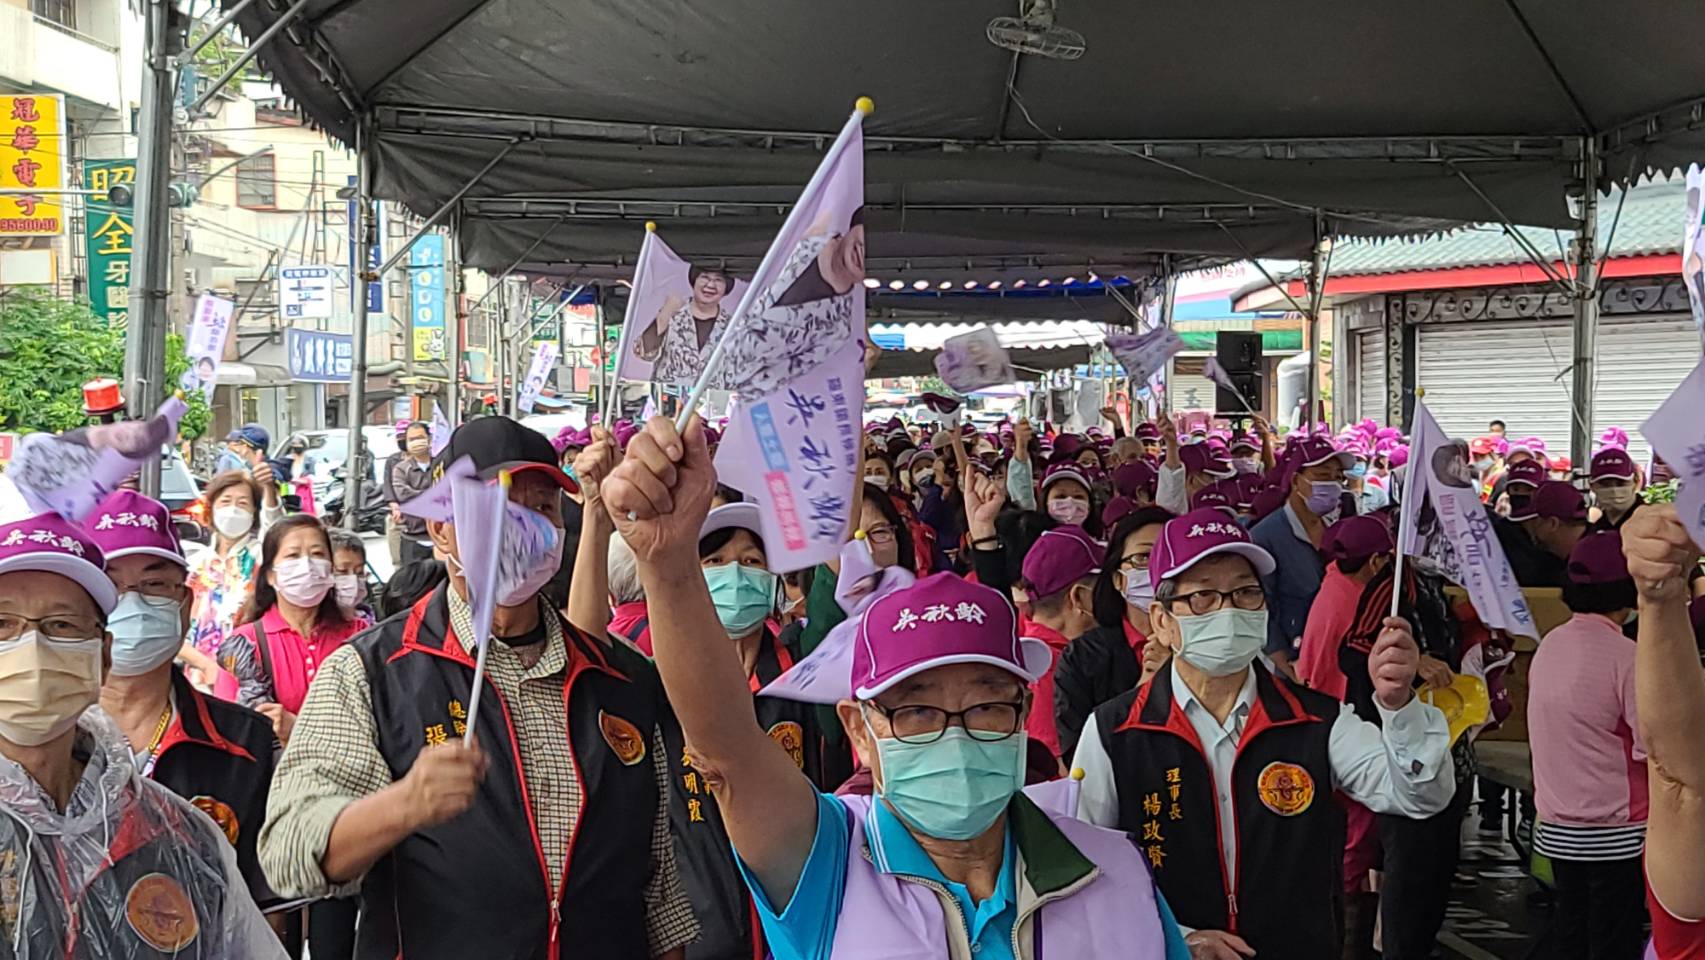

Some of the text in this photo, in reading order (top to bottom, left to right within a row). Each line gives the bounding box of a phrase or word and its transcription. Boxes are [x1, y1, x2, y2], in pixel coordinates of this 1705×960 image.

[10, 97, 44, 216] 冠華電子
[95, 511, 160, 532] 吳秋齡
[1185, 522, 1242, 539] 吳秋齡
[0, 528, 86, 557] 吳秋齡
[892, 601, 988, 632] 吳秋齡
[425, 723, 449, 748] 張
[1165, 767, 1184, 821] 理事長
[1141, 793, 1168, 870] 楊政賢
